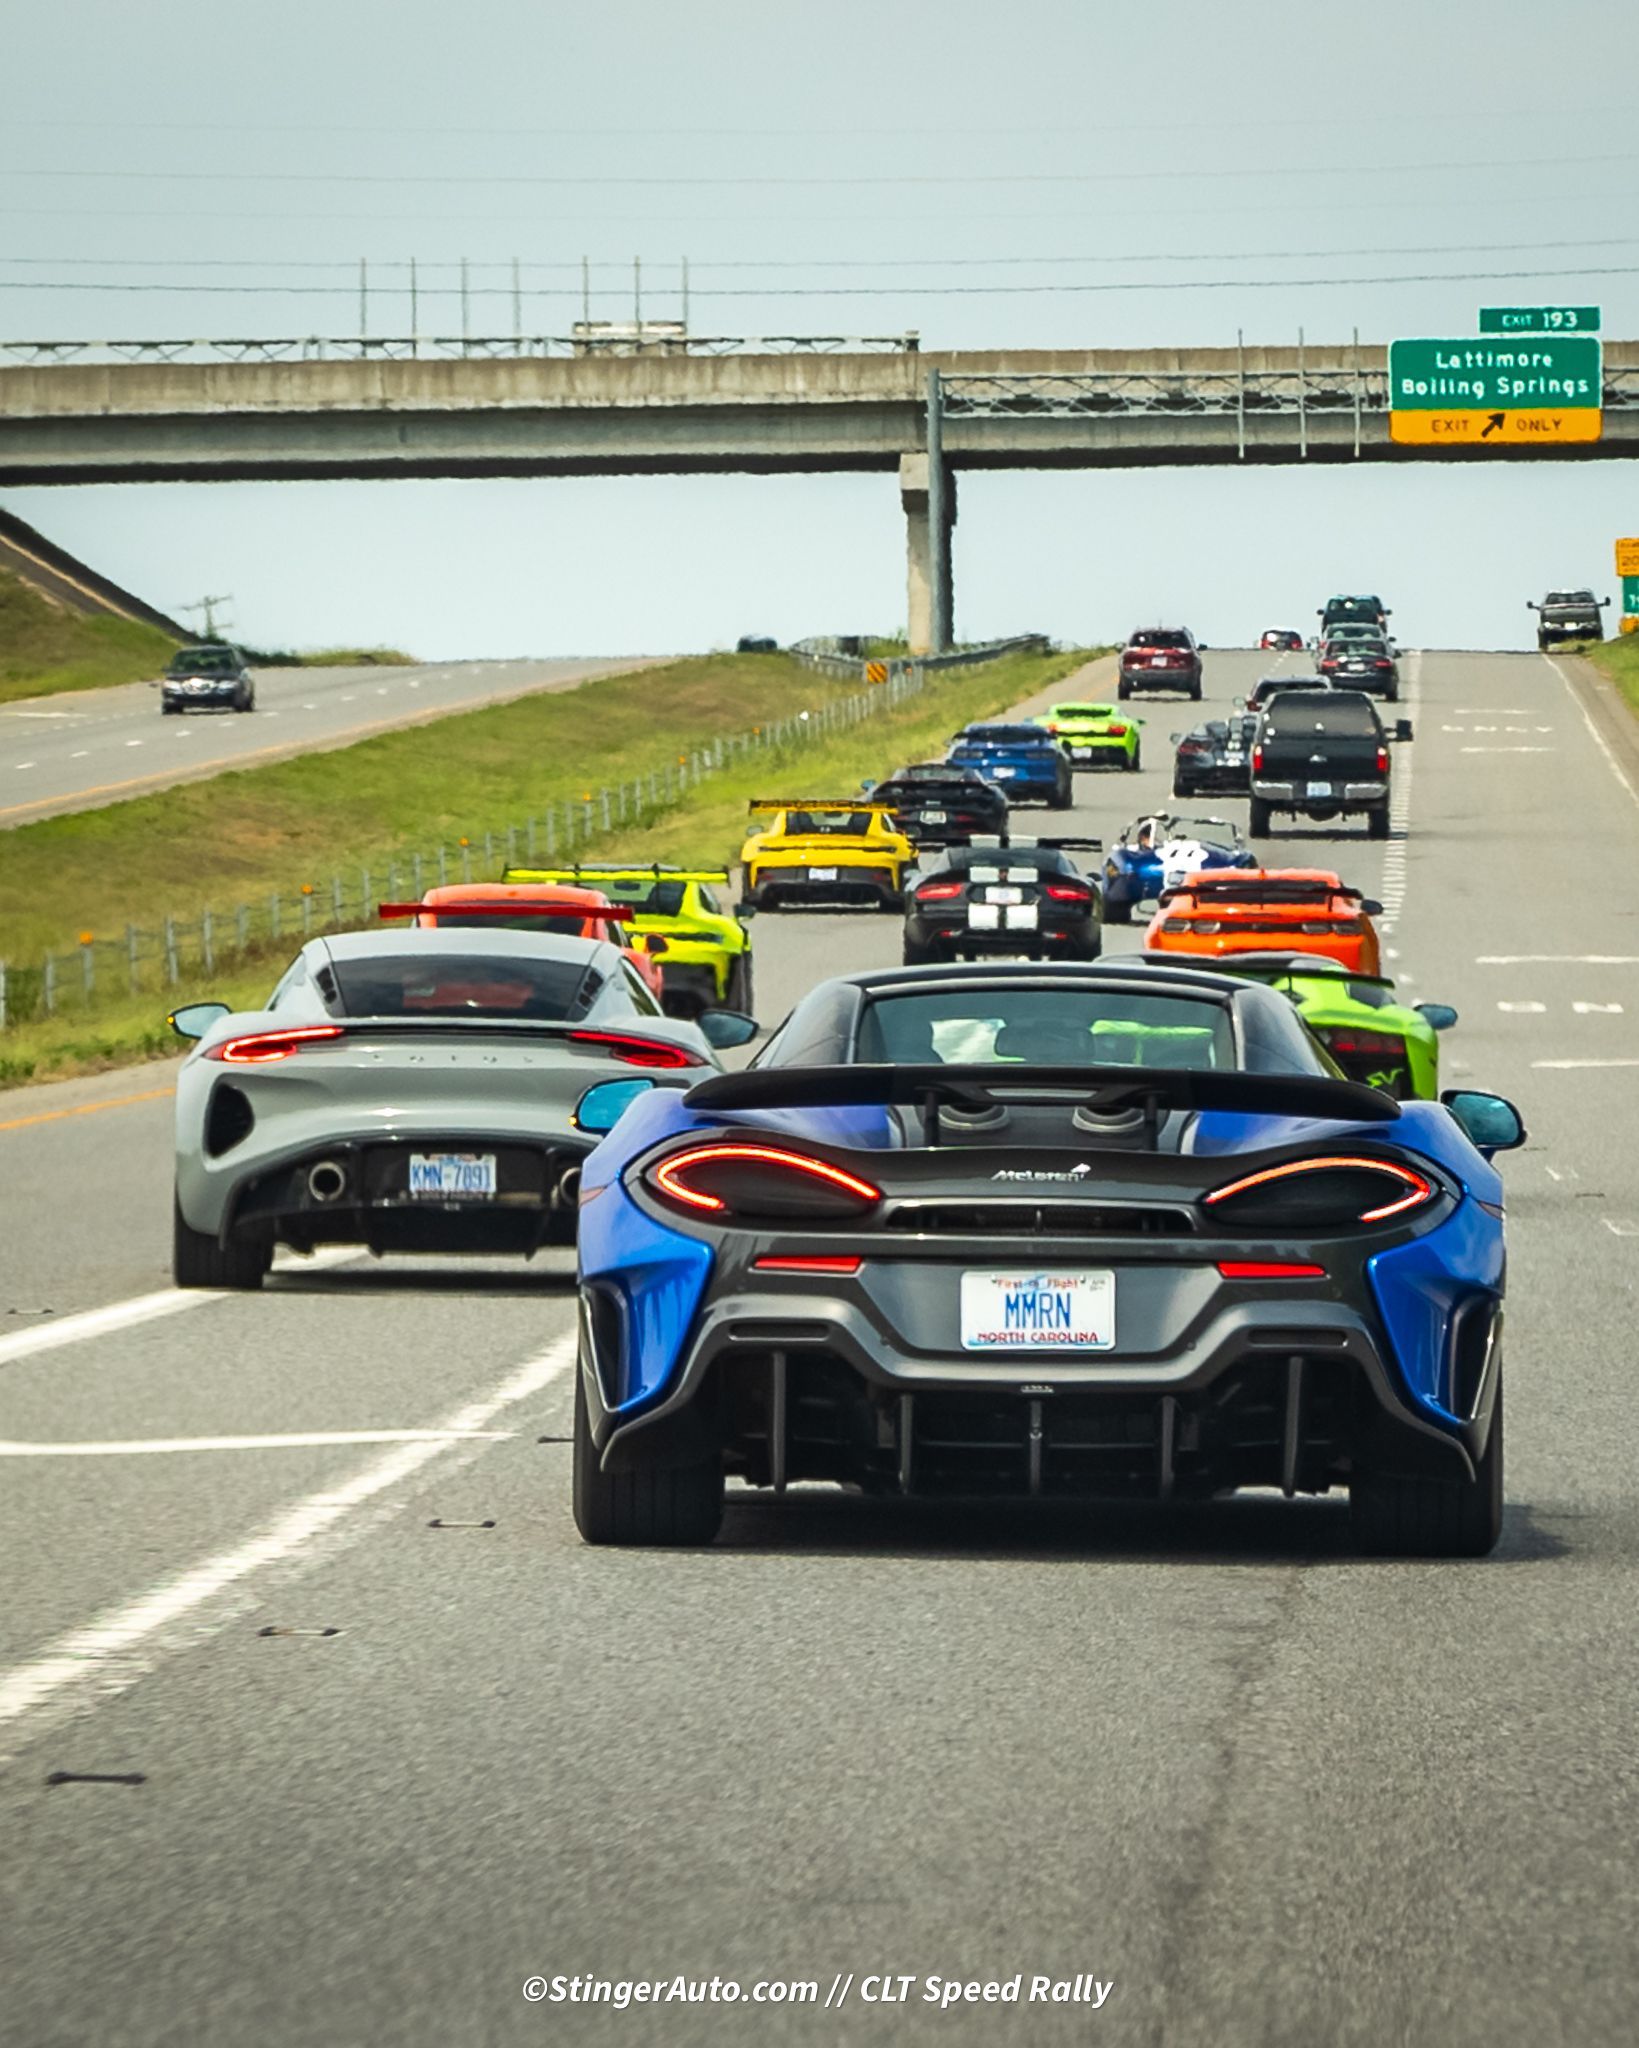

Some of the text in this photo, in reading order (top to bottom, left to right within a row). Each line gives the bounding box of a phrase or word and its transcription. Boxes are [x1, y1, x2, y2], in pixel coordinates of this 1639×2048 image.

[1502, 311, 1578, 327] EXIT 193
[1436, 351, 1553, 368] Lattimore
[1402, 376, 1589, 400] Boiling Springs
[1431, 418, 1562, 432] EXIT ONLY
[1006, 1293, 1071, 1328] MMRN
[978, 1332, 1098, 1342] NORTH CAROLINA
